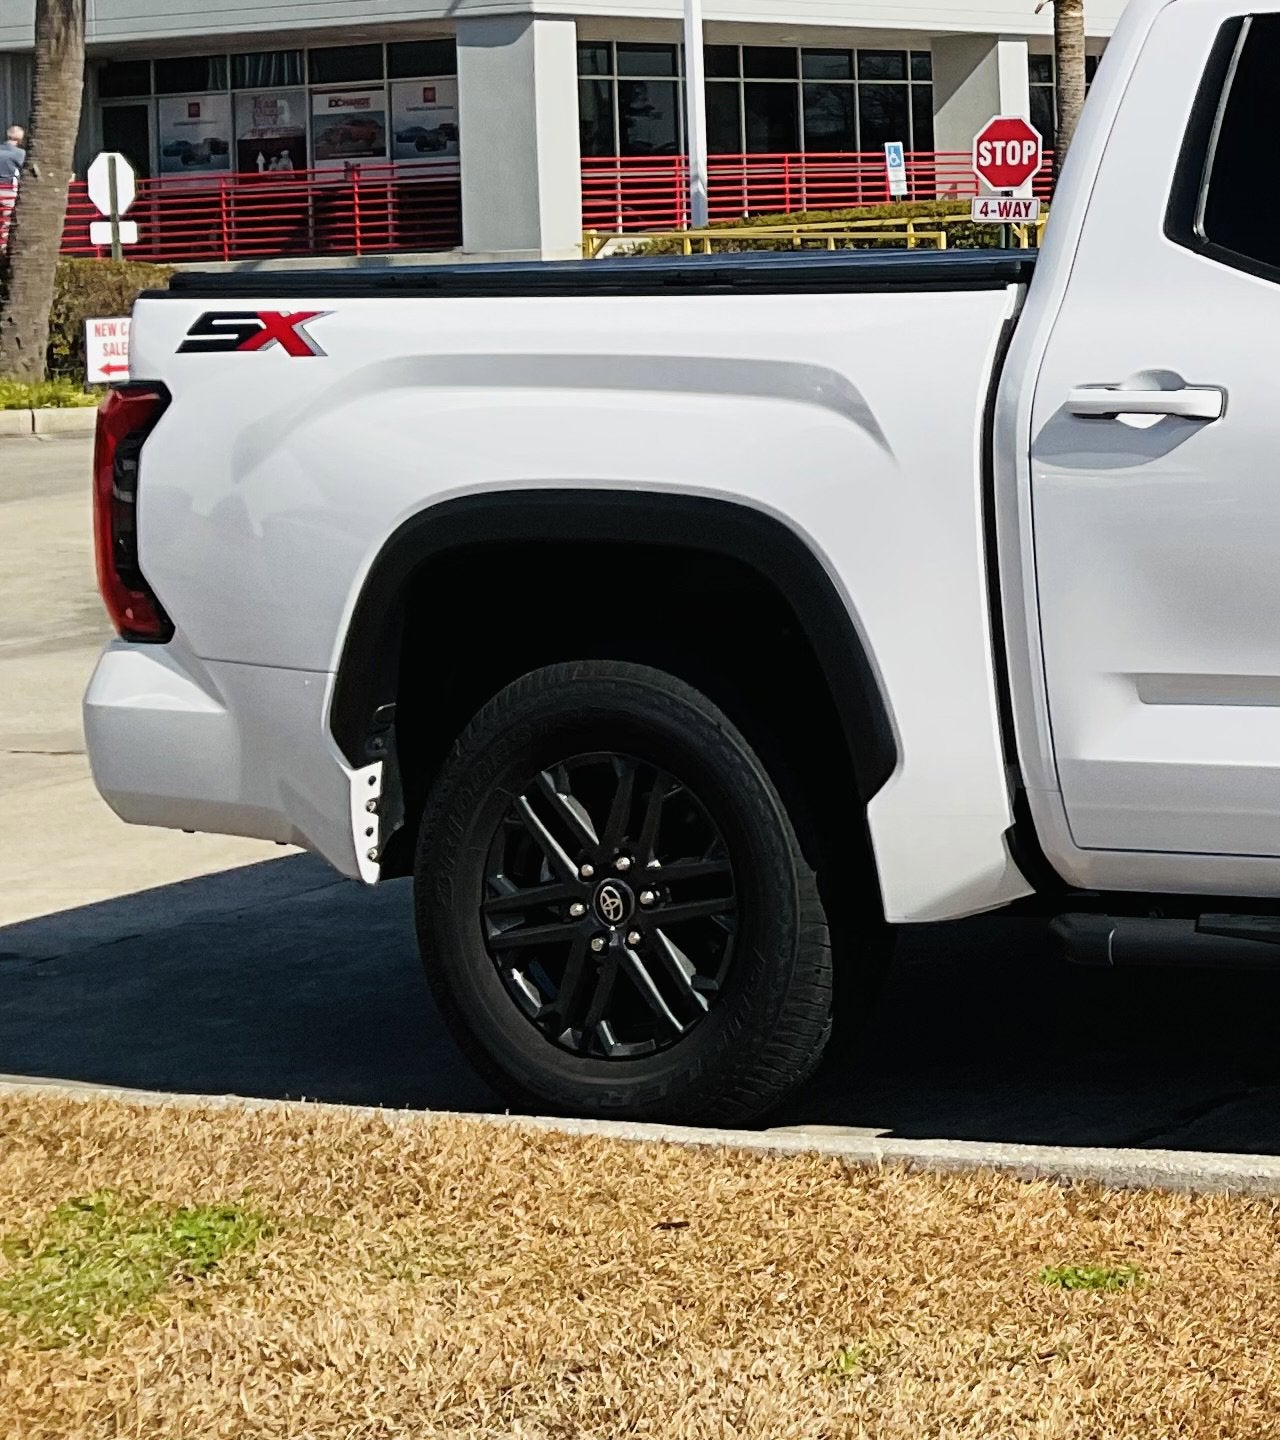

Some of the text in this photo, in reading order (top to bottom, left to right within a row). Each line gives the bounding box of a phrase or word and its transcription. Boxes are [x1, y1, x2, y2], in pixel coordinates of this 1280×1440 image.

[979, 140, 1036, 167] STOP
[980, 201, 1032, 217] 4-WAY
[95, 323, 117, 337] NEW
